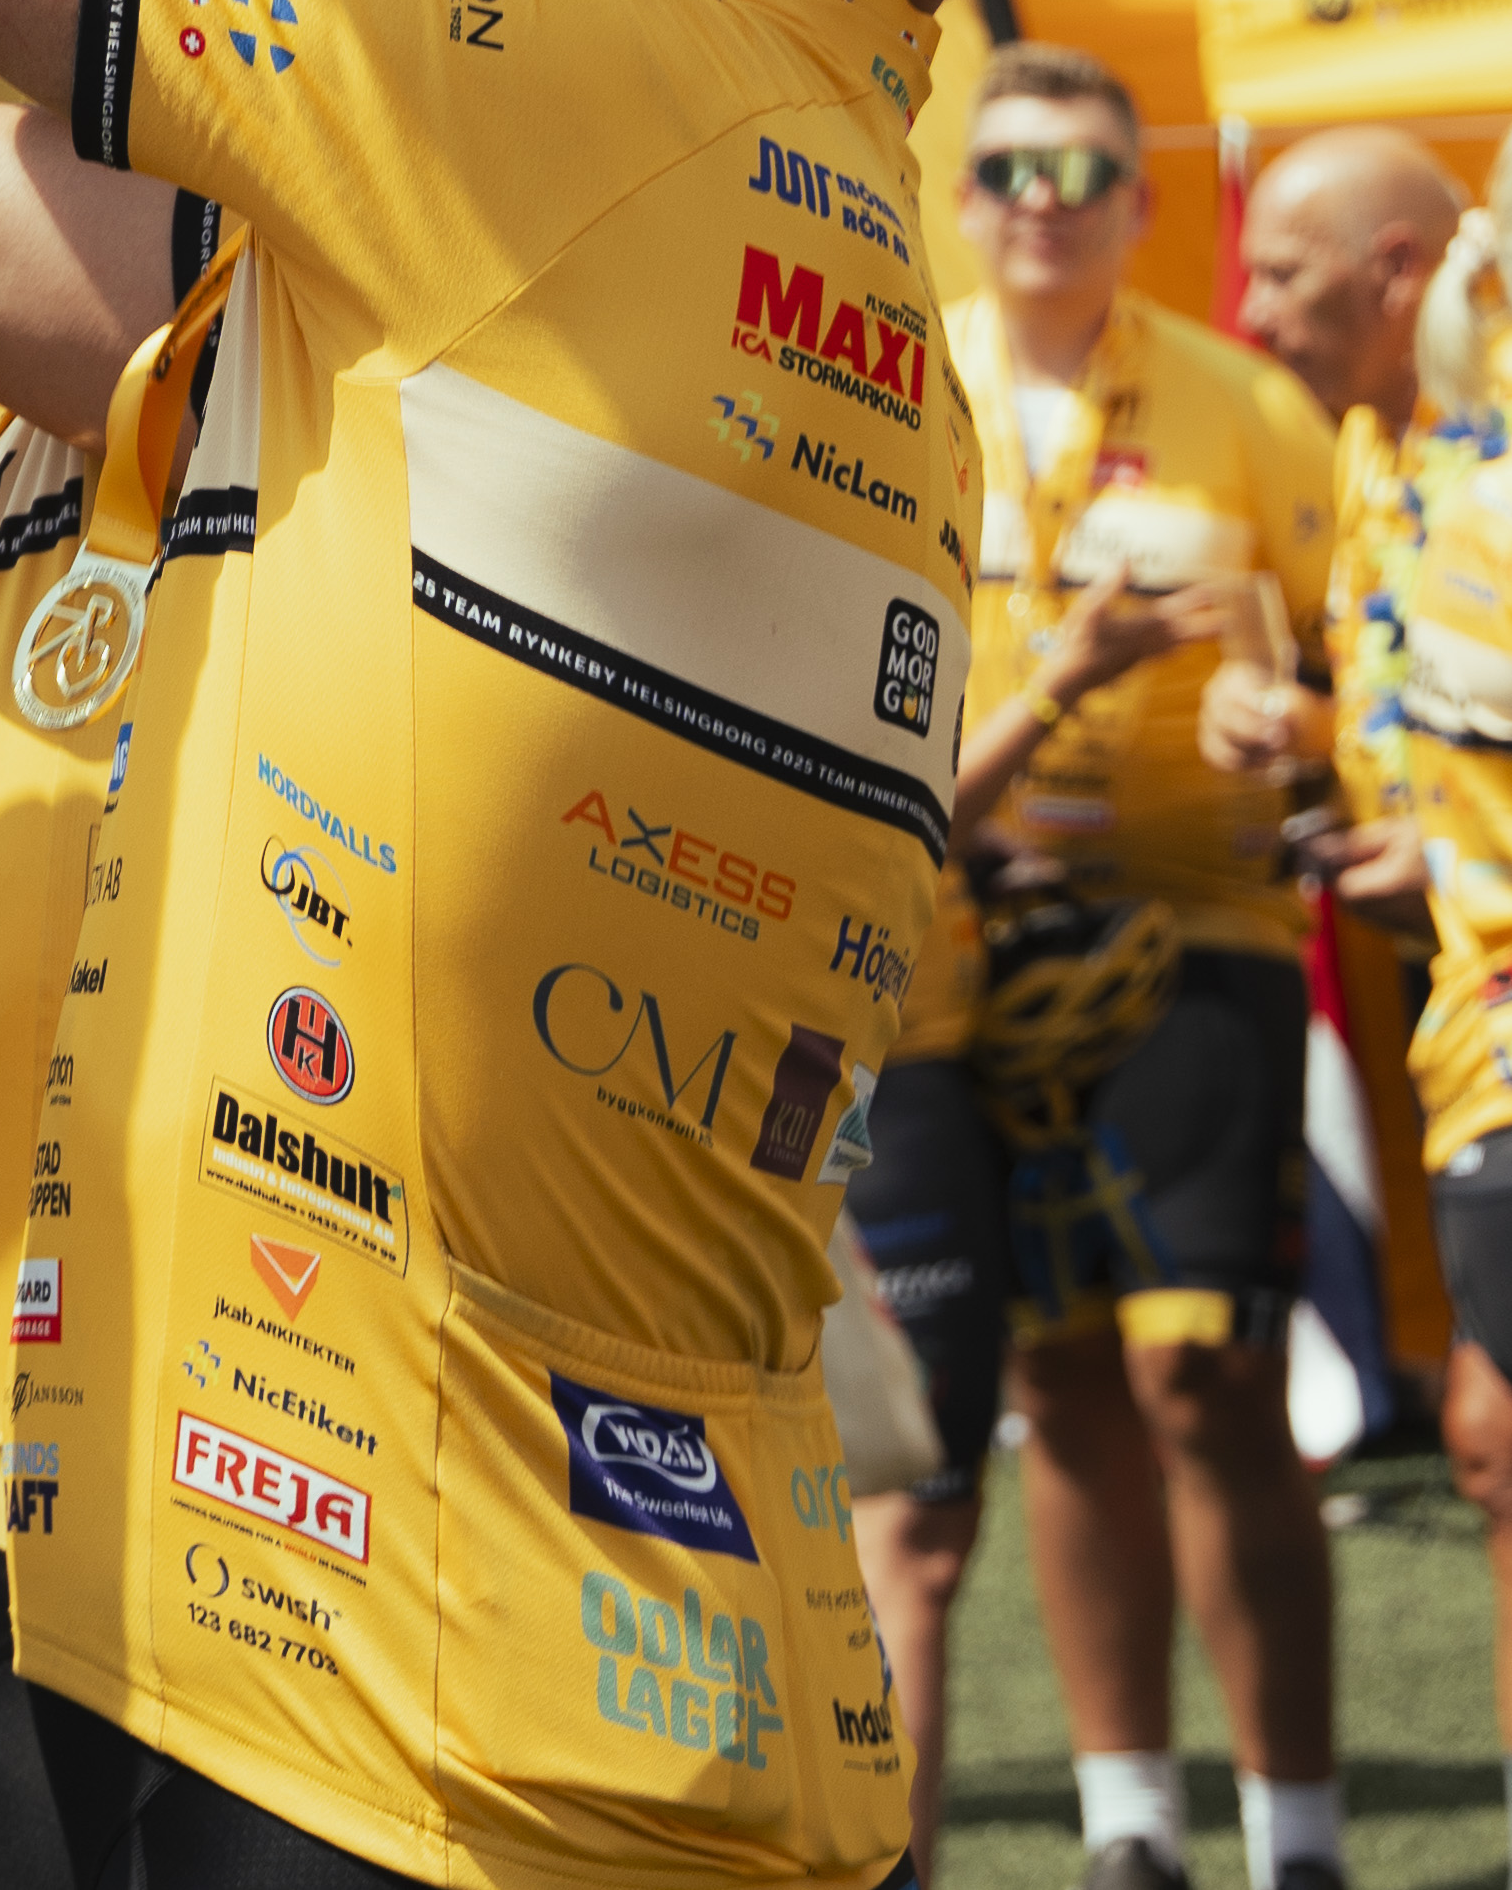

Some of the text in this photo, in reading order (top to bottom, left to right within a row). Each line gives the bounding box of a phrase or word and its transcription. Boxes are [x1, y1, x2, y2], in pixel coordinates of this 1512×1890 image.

[101, 20, 124, 167] HELSINGBORG
[731, 326, 773, 365] ICA
[735, 243, 926, 408] MAXI
[778, 345, 922, 432] STORMARKNAD
[789, 432, 919, 525] NicLam
[885, 643, 934, 693] MOR
[891, 609, 938, 661] GOD
[441, 585, 503, 634] TEAM
[508, 622, 618, 688] RYNKEBY
[622, 674, 769, 757] HELSINGBORG
[771, 743, 815, 777] 2025
[818, 763, 857, 793] TEAM
[257, 752, 398, 875] NORDVALLS
[560, 788, 798, 922] AXESS
[588, 845, 762, 943] LOGISTICS
[531, 961, 738, 1130] CM
[33, 1140, 62, 1178] STAD
[212, 1090, 393, 1226] Dalshult
[213, 1295, 357, 1377] jkab ARKITEKTER
[5, 1480, 61, 1536] AFT
[184, 1428, 355, 1541] FREJA
[186, 1601, 223, 1635] 123
[580, 1569, 778, 1709] ODLAR
